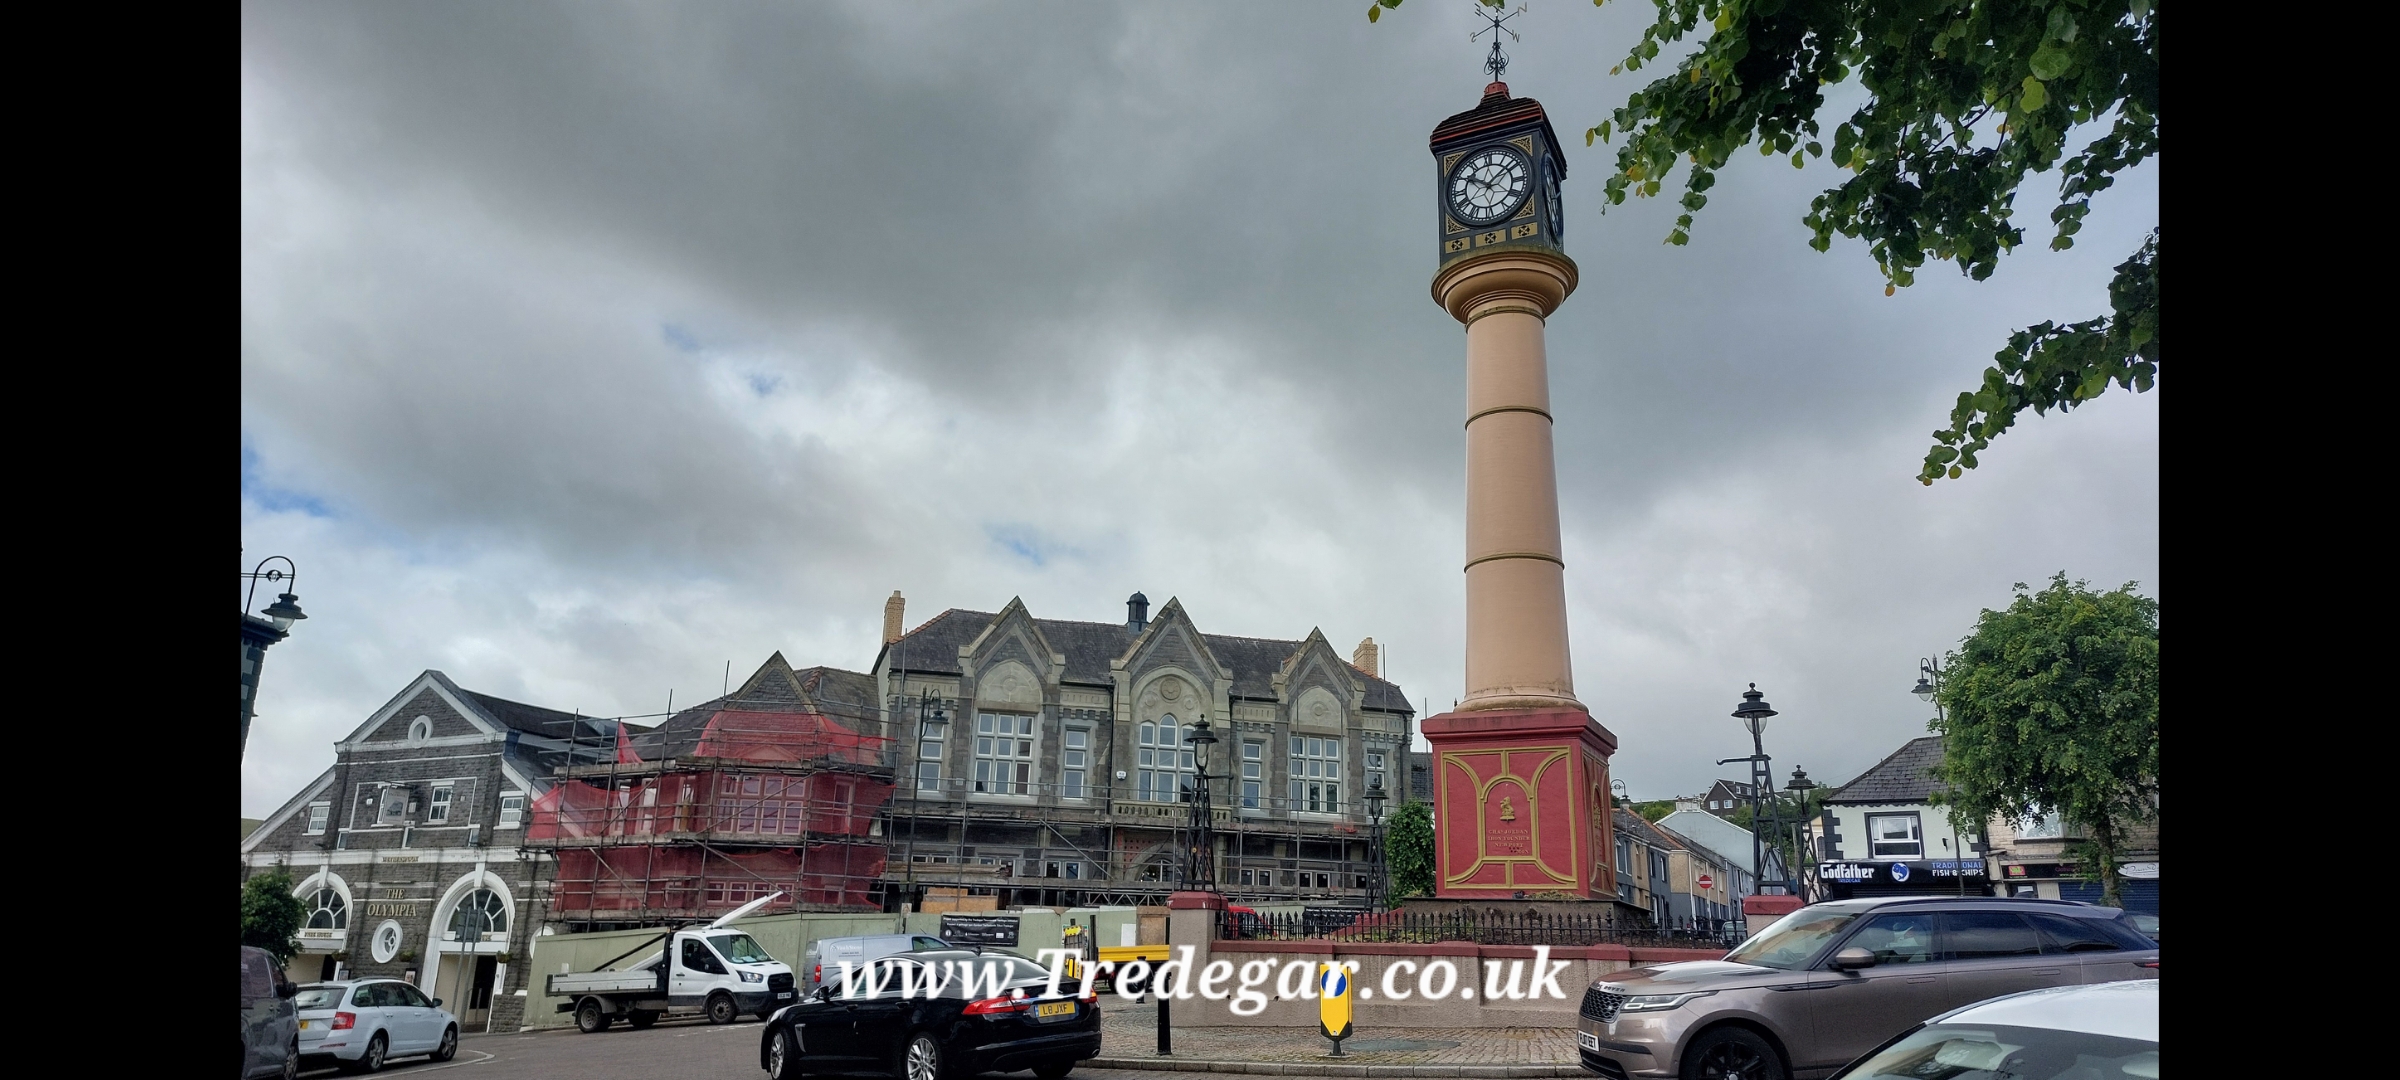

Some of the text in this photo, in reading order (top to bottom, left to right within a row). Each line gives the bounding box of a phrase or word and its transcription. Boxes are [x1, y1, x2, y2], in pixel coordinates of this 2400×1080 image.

[1820, 864, 1874, 878] Godfather
[386, 889, 405, 899] THE
[367, 904, 416, 916] OLYMPIA
[1043, 1004, 1067, 1015] L8 JXF
